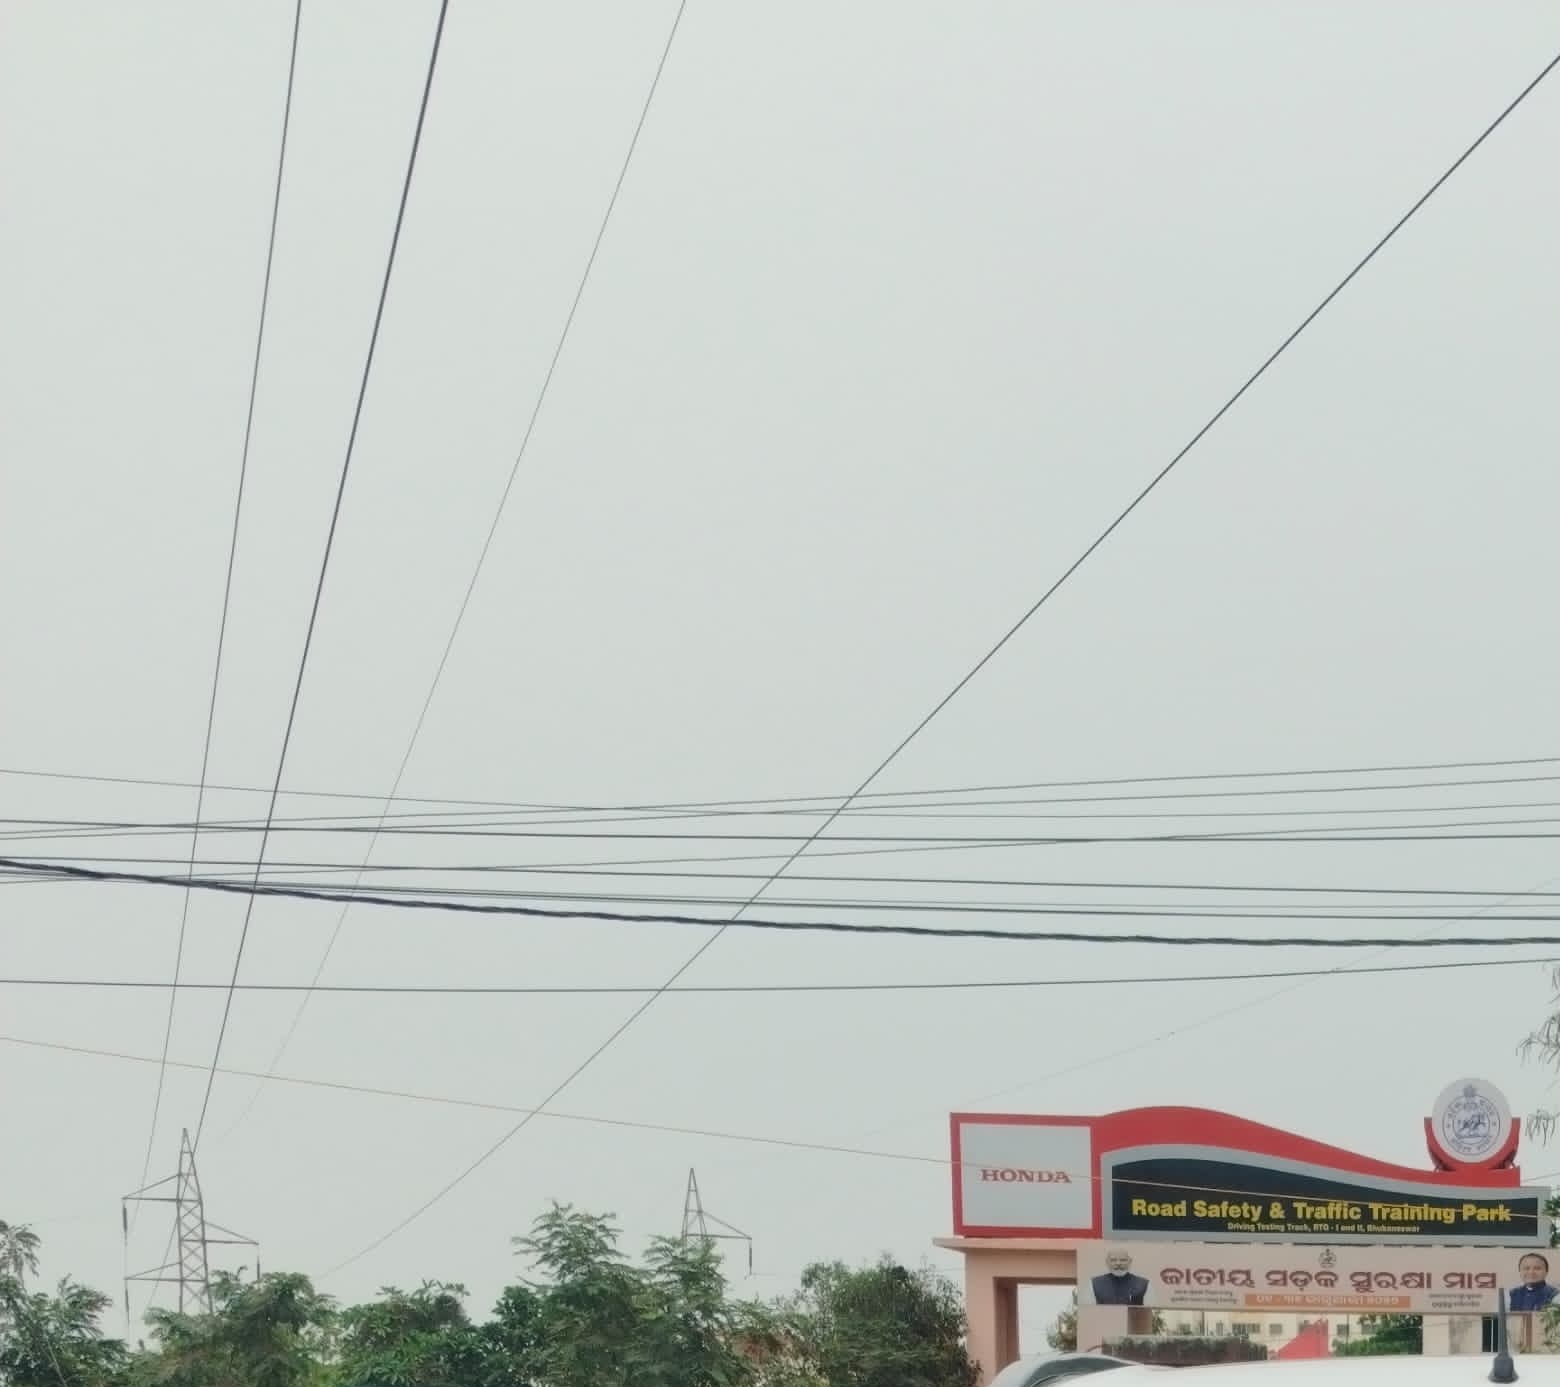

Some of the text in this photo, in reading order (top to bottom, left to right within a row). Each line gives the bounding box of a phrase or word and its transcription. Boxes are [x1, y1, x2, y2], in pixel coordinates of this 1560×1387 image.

[981, 1168, 1072, 1184] HONDA
[1132, 1199, 1512, 1224] Road Safety & Traffic Training Park
[1228, 1222, 1256, 1232] Driving
[1257, 1223, 1285, 1233] Testing
[1313, 1223, 1329, 1231] RTO
[1341, 1223, 1356, 1231] and
[1443, 1272, 1497, 1289] ମାସ
